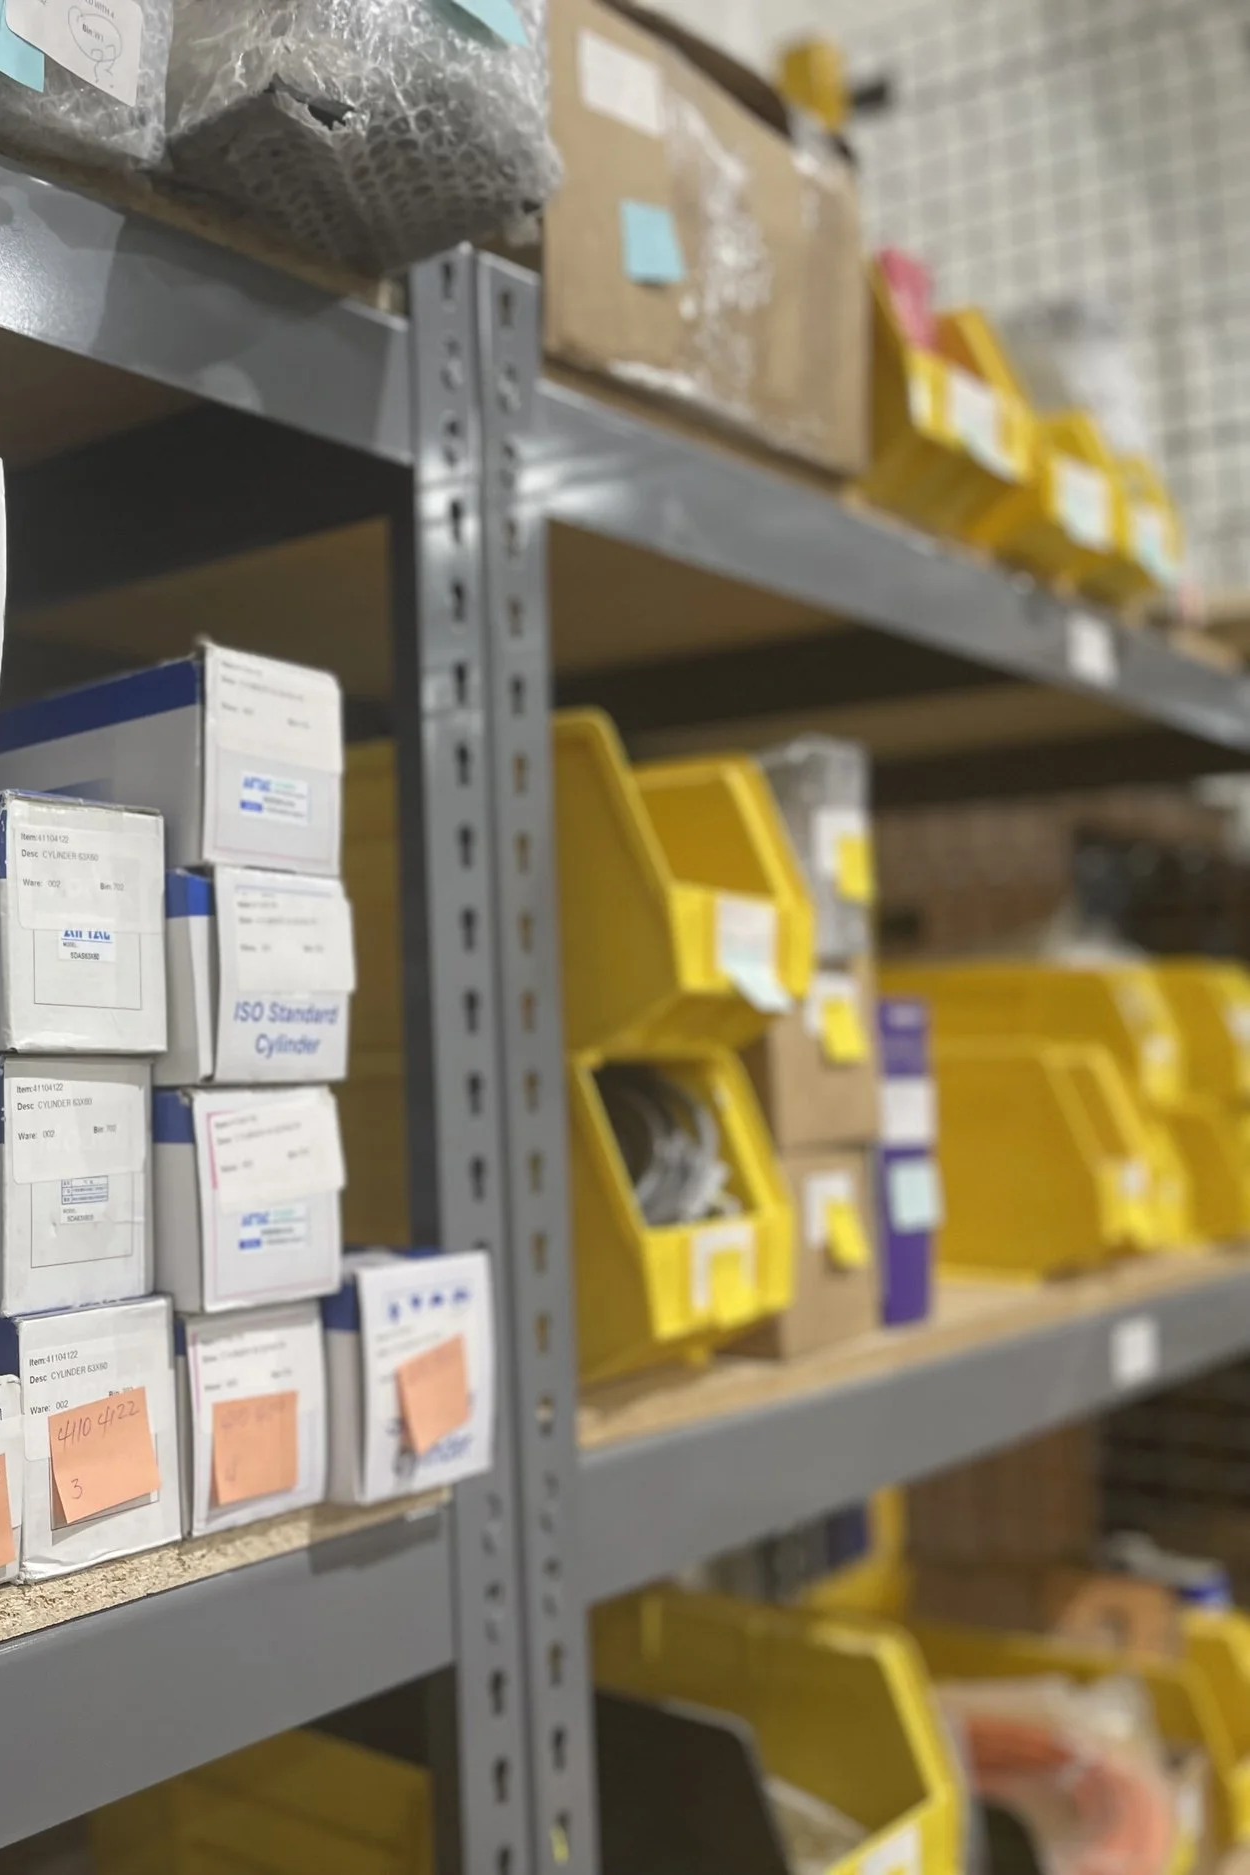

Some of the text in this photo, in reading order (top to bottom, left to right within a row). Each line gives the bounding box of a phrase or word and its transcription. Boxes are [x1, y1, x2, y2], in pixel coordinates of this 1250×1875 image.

[42, 850, 77, 860] CYLINDER
[233, 1001, 339, 1026] ISO Standard
[255, 1033, 321, 1059] Cylinder
[17, 1102, 35, 1111] Desc
[38, 1099, 72, 1110] CYLINDER
[29, 1373, 48, 1384] Desc
[51, 1366, 87, 1381] CYLINDER
[30, 1400, 69, 1415] Ware: 002
[57, 1416, 92, 1450] 4110
[70, 1478, 83, 1499] 3
